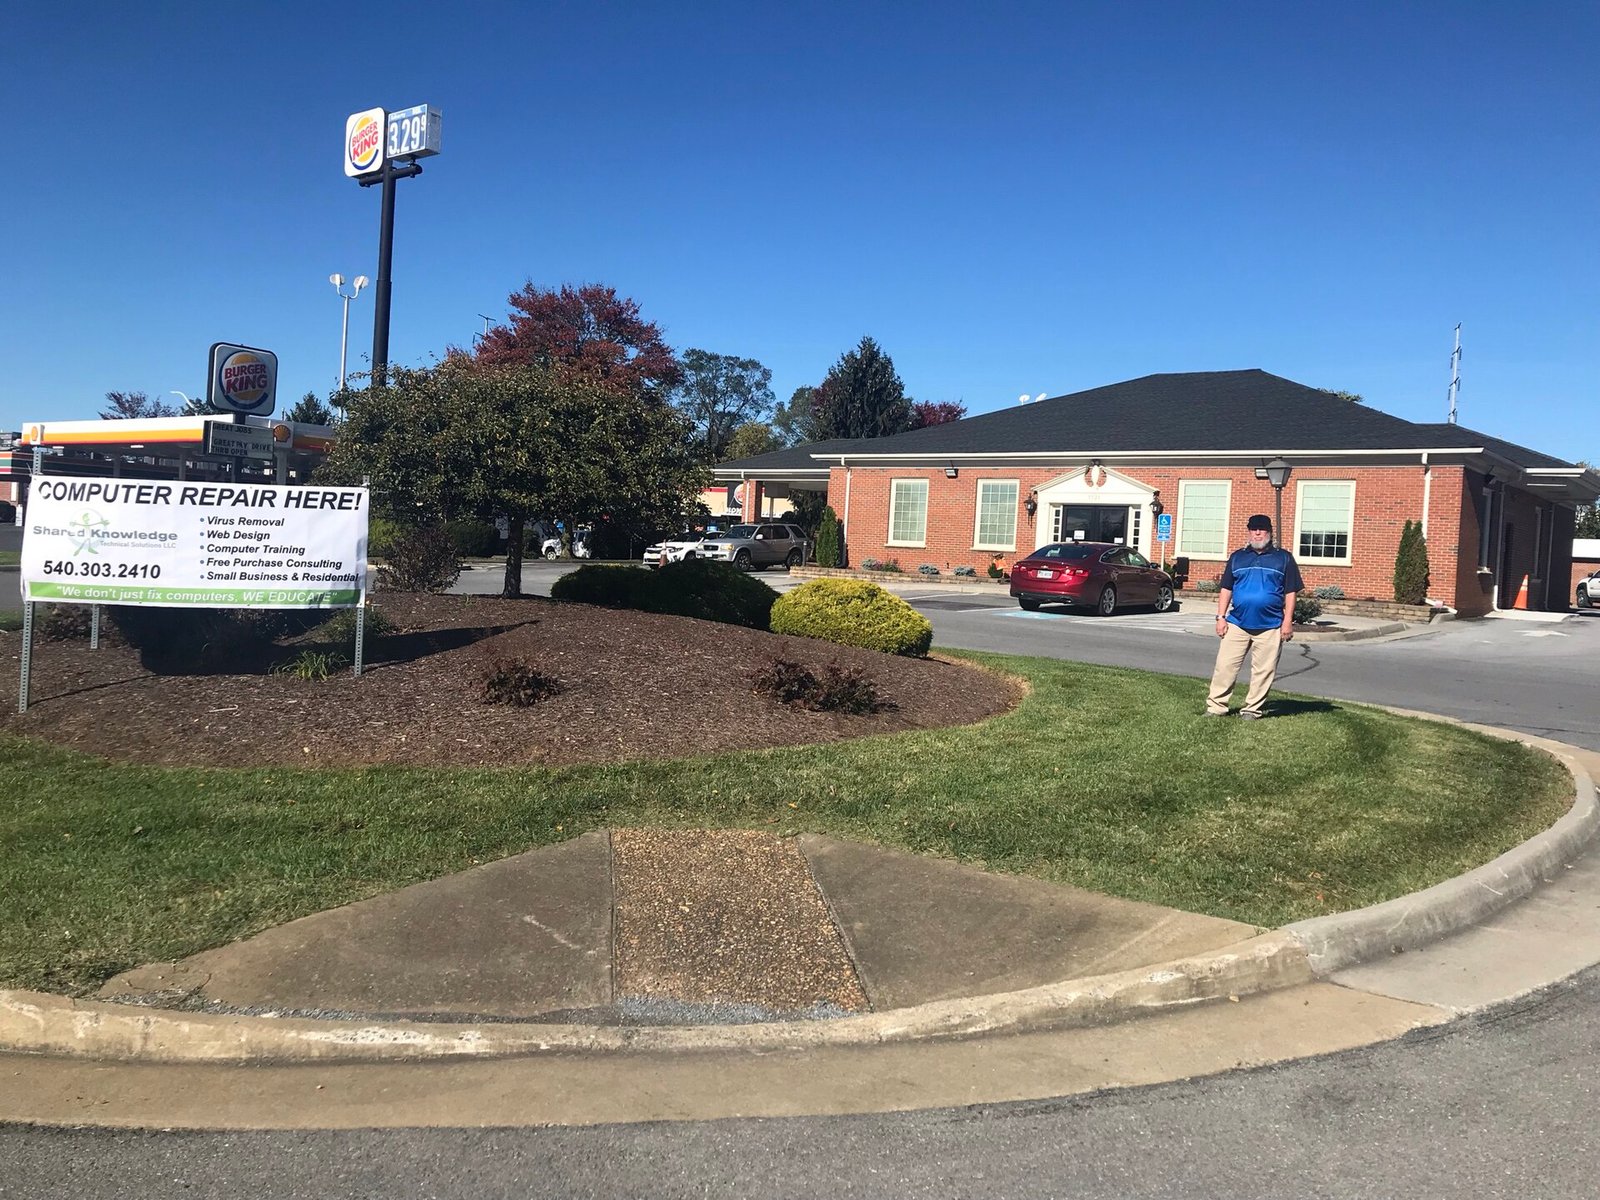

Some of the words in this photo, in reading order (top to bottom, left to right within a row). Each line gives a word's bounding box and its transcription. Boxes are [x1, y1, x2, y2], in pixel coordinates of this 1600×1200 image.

[352, 121, 378, 147] BURGER
[352, 131, 378, 160] KING
[224, 364, 266, 379] BURGER
[225, 374, 267, 395] KING
[213, 438, 235, 448] GREAT
[236, 440, 248, 449] PAY
[252, 443, 271, 451] DRIVE
[231, 448, 248, 456] OPEN
[38, 481, 172, 505] COMPUTER
[179, 486, 277, 508] REPAIR
[284, 490, 362, 511] HERE!
[207, 516, 235, 526] Virus
[238, 517, 285, 527] Removal
[33, 526, 85, 537] Shared
[91, 529, 178, 542] Knowledge
[207, 530, 230, 540] Web
[233, 531, 271, 542] Design
[131, 541, 162, 549] Solutions
[207, 544, 260, 555] Computer
[263, 545, 306, 556] Training
[43, 560, 161, 579] 540.303.2410
[207, 558, 230, 567] Free
[233, 558, 283, 567] Purchase
[286, 559, 343, 570] Consulting
[207, 571, 237, 581] Small
[239, 572, 288, 581] Business
[291, 572, 299, 582] &
[302, 573, 359, 582] Residential
[57, 586, 81, 597] "We
[85, 587, 116, 598] don't
[118, 589, 143, 600] just
[147, 588, 162, 600] fix
[166, 591, 238, 603] computers,
[243, 591, 264, 601] WE
[268, 592, 337, 603] EDUCATE"
